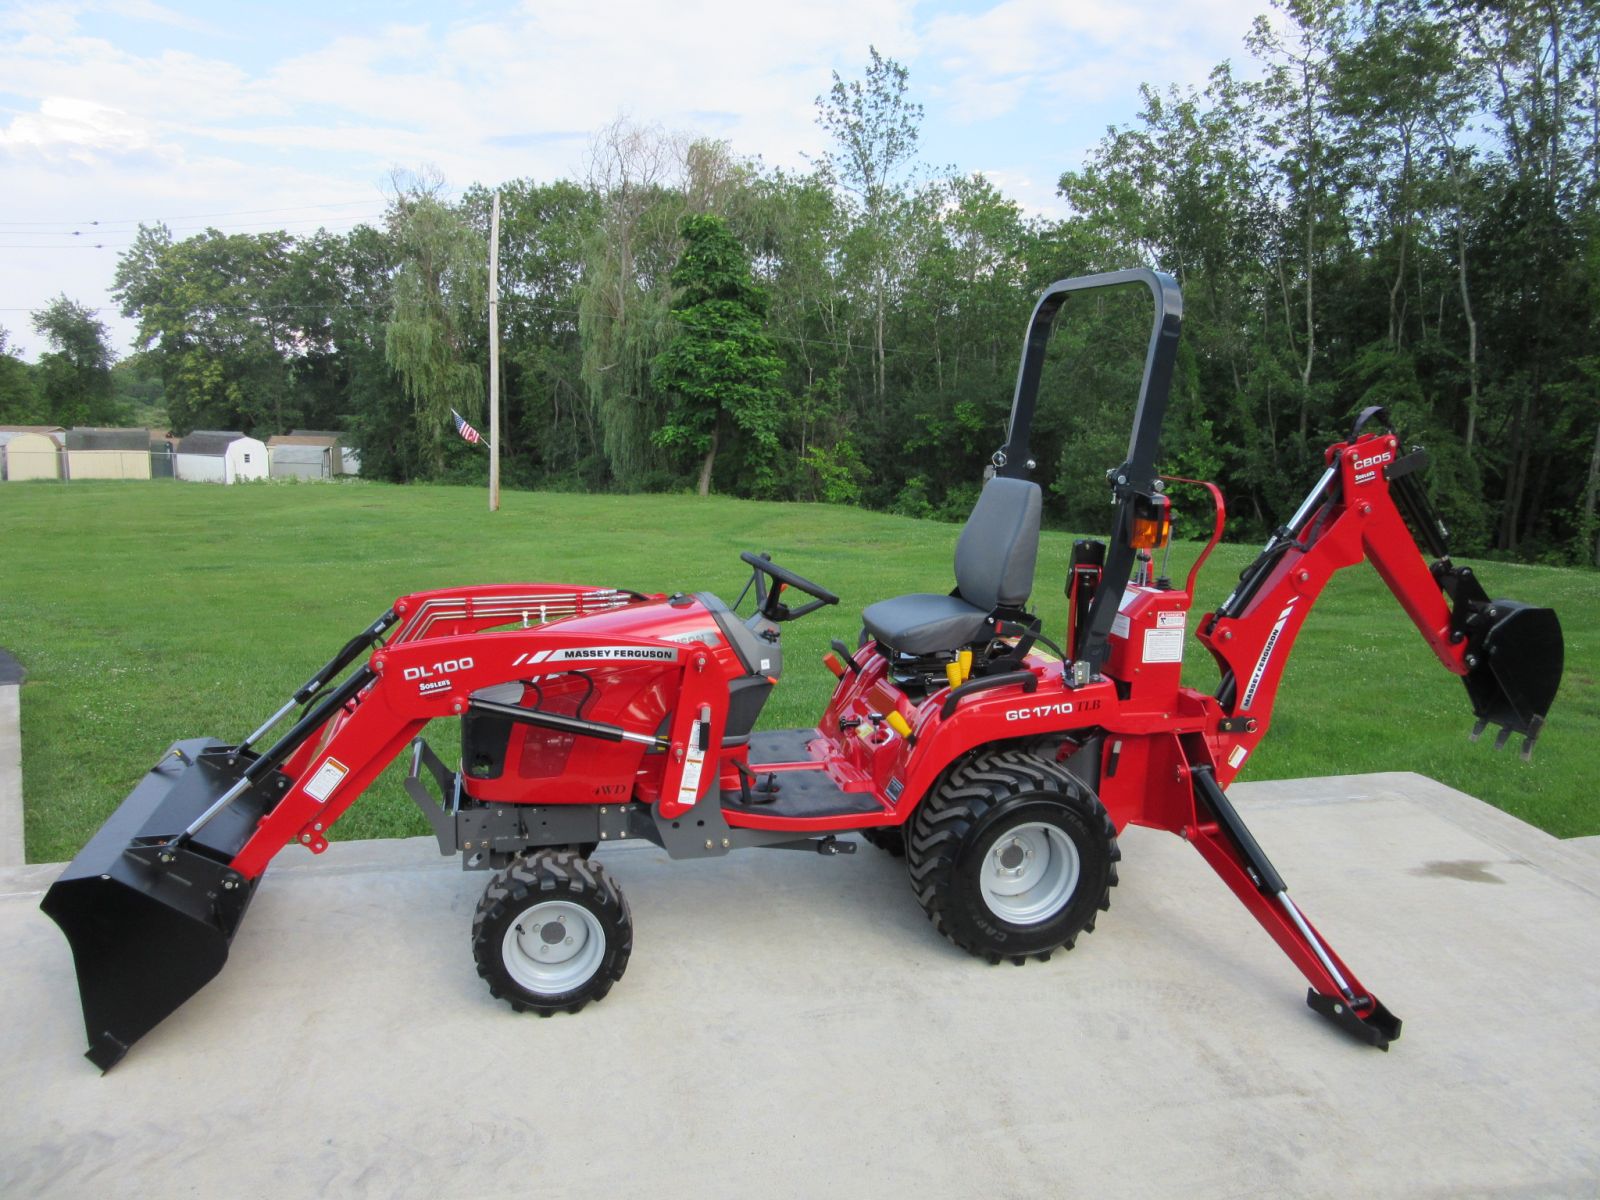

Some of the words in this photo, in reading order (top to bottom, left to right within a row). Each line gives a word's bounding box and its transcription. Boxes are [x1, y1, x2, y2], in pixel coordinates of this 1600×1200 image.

[564, 650, 611, 658] MASSEY
[613, 649, 672, 659] FERGUSON
[403, 657, 474, 681] DL100
[1244, 674, 1260, 707] MASSEY
[1258, 629, 1279, 672] FERGUSON
